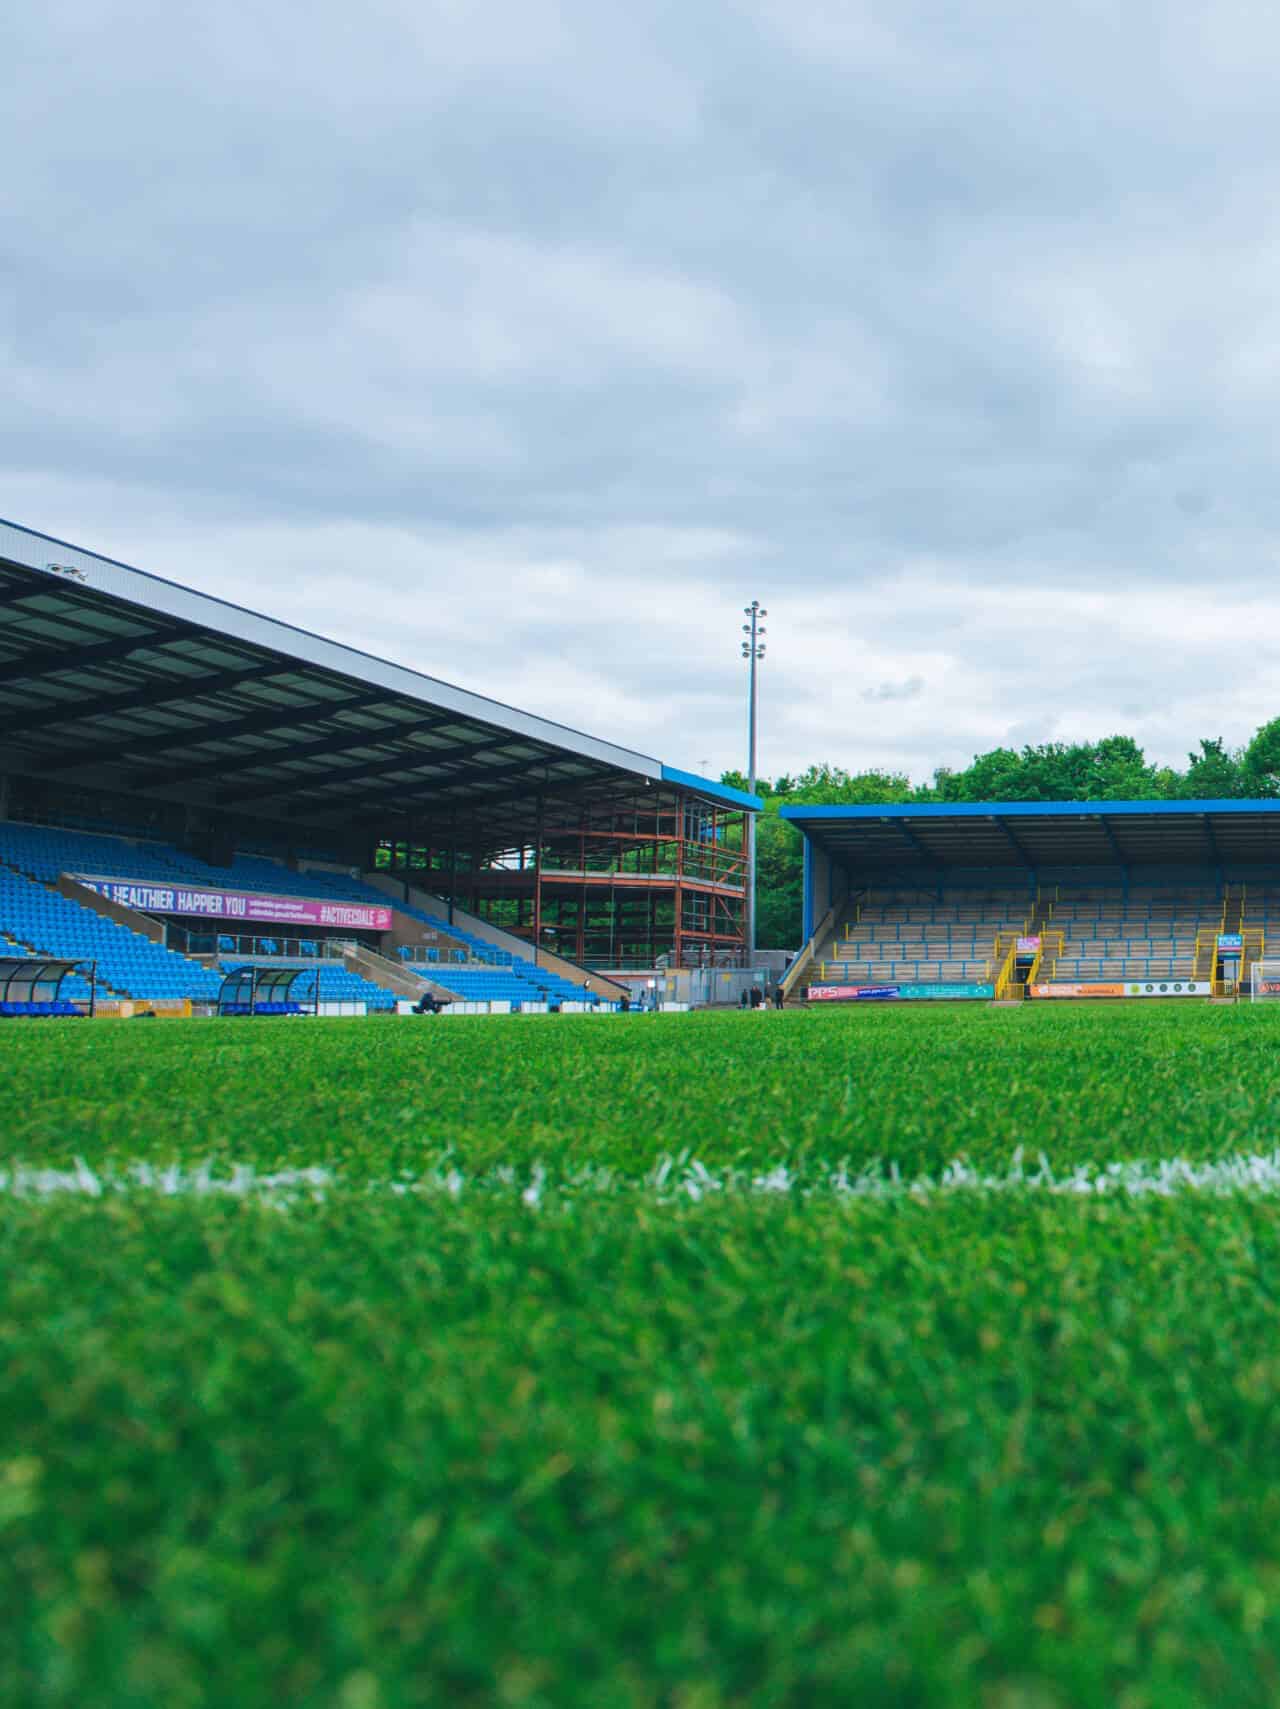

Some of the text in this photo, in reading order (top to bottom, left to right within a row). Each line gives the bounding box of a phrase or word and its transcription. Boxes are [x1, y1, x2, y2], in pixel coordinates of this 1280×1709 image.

[113, 885, 174, 909] HEALTHIER
[177, 892, 223, 914] HAPPIER
[225, 896, 246, 916] YOU
[809, 986, 839, 997] PPS
